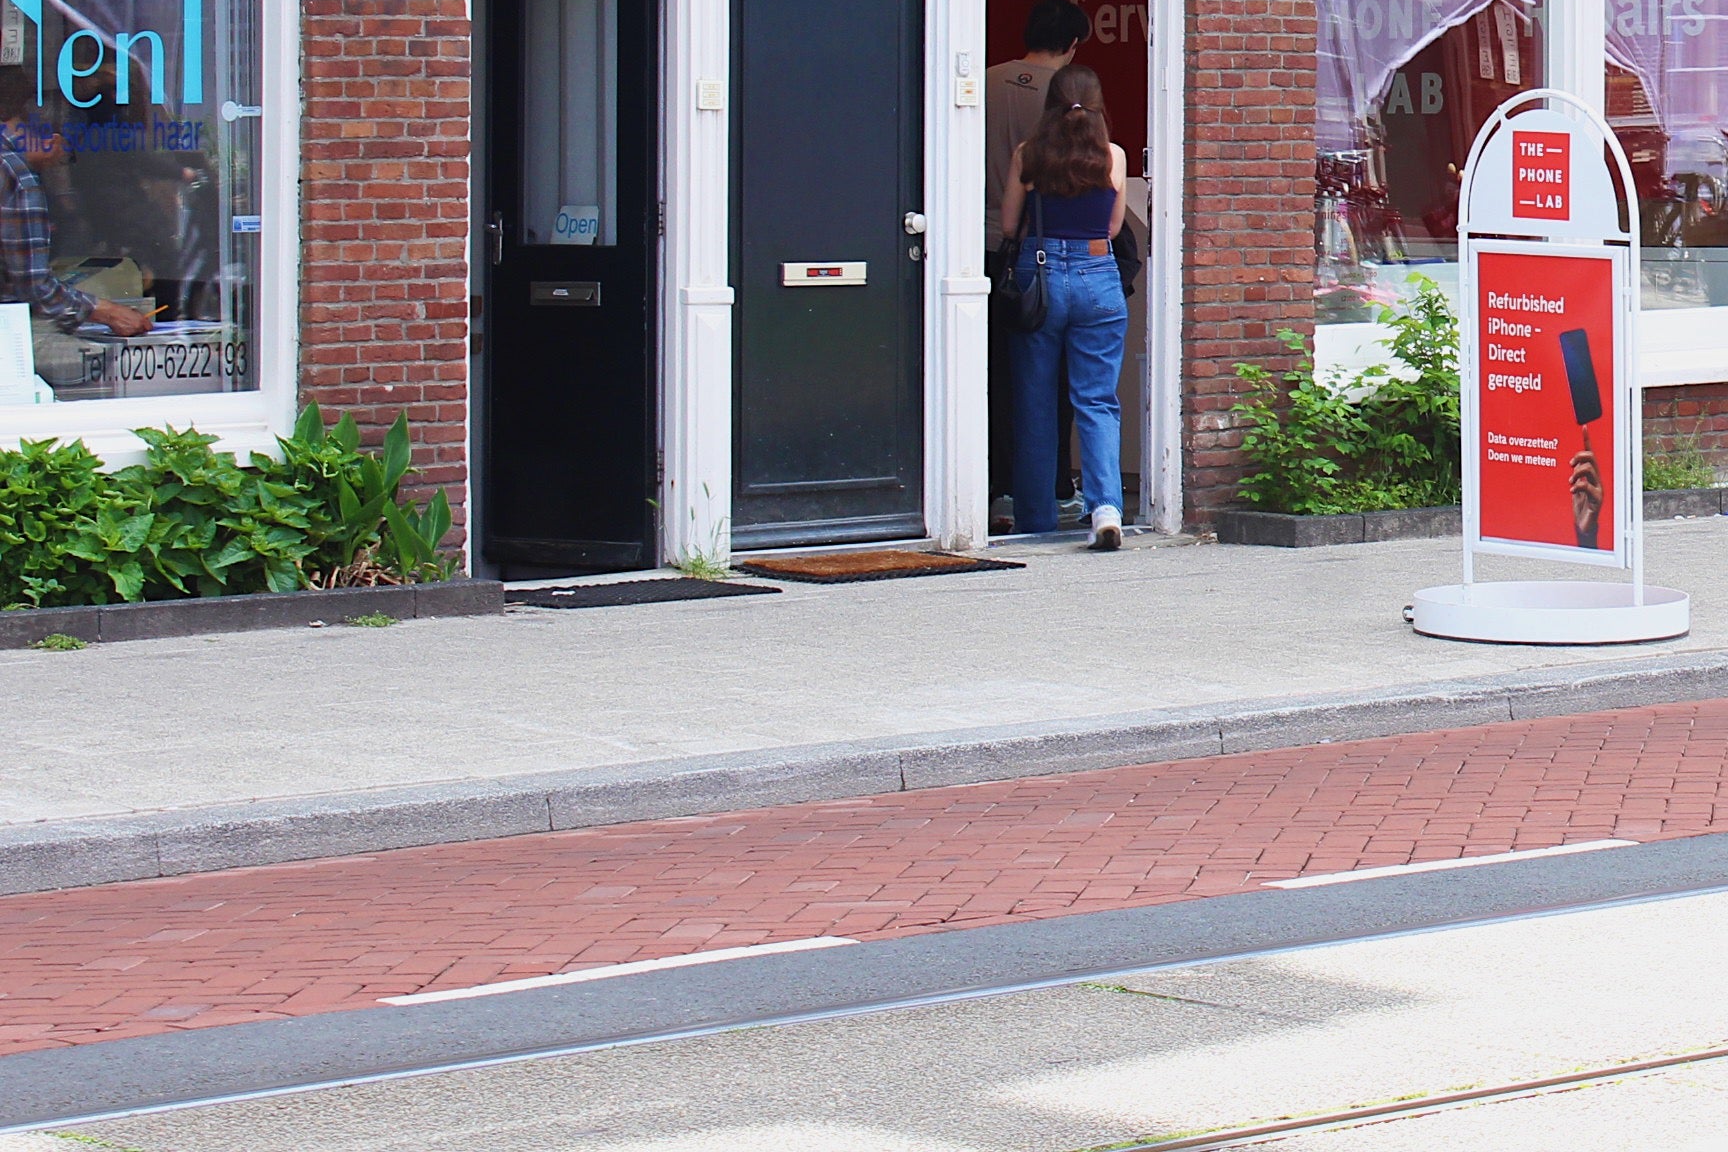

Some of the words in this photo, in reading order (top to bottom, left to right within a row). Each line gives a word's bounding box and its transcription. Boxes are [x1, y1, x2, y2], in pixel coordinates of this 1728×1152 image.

[153, 112, 203, 151] haar
[1519, 142, 1544, 157] THE
[1519, 167, 1563, 184] PHONE
[1536, 193, 1563, 209] LAB
[555, 212, 597, 238] Open
[1487, 291, 1565, 314] Refurbished
[1487, 317, 1532, 338] iPhone
[1487, 343, 1526, 363] Direct
[1487, 373, 1542, 394] geregeld
[1487, 431, 1507, 445] Data
[1508, 435, 1559, 450] overzetten?
[1487, 449, 1510, 463] Doen
[1511, 453, 1524, 464] we
[1524, 455, 1557, 468] meteen
